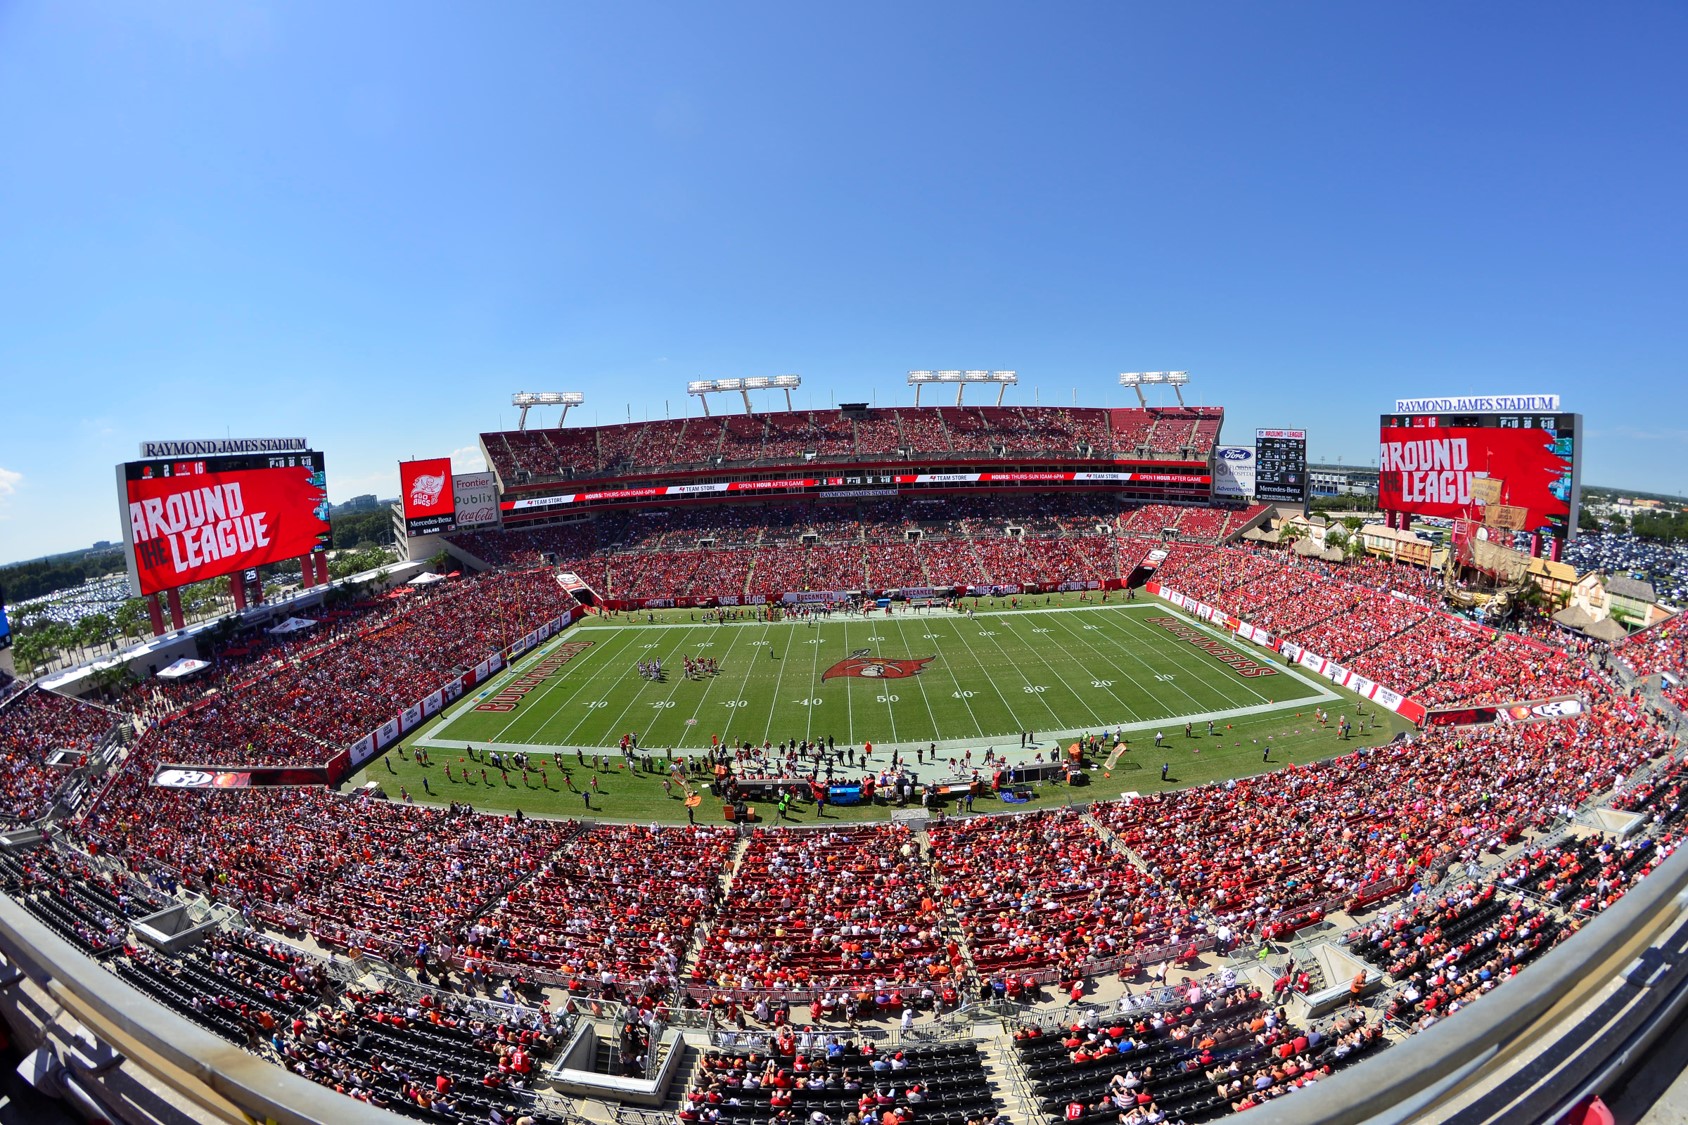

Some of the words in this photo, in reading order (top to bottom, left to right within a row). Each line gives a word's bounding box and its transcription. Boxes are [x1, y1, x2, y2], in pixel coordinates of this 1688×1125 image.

[1398, 400, 1451, 412] RAYMOND
[1454, 398, 1493, 410] JAMES
[1495, 396, 1553, 410] STADIUM
[1404, 417, 1410, 427] 2
[1428, 417, 1436, 427] 16
[146, 442, 216, 457] RAYMOND
[218, 440, 257, 453] JAMES
[260, 438, 306, 451] STADIUM
[1224, 448, 1247, 460] Ford
[1381, 438, 1468, 472] AROUND
[163, 464, 170, 477] 2
[195, 462, 203, 475] 16
[456, 479, 489, 488] Frontier
[1259, 485, 1300, 493] Mercedes-Benz
[413, 498, 430, 507] BUCS
[129, 482, 244, 544] AROUND
[457, 507, 494, 524] Coca-Cola
[411, 517, 452, 527] Mercedes-Benz
[167, 512, 271, 574] LEAGUE
[138, 537, 168, 571] THE
[245, 571, 256, 580] 25
[718, 596, 740, 605] RAISE
[744, 595, 766, 604] FLAGS
[796, 592, 834, 602] BUCCANEERS
[1144, 617, 1279, 678] BUCCANEERS
[474, 640, 595, 713] BUCCANEERS
[1154, 674, 1174, 682] 10
[1090, 680, 1111, 688] 20
[952, 690, 973, 698] 40
[1023, 686, 1044, 694] 30
[800, 698, 823, 706] 40
[876, 694, 899, 702] 50
[654, 700, 676, 708] 20
[725, 700, 748, 708] 30
[514, 1056, 522, 1065] 13
[1071, 1108, 1081, 1116] 13
